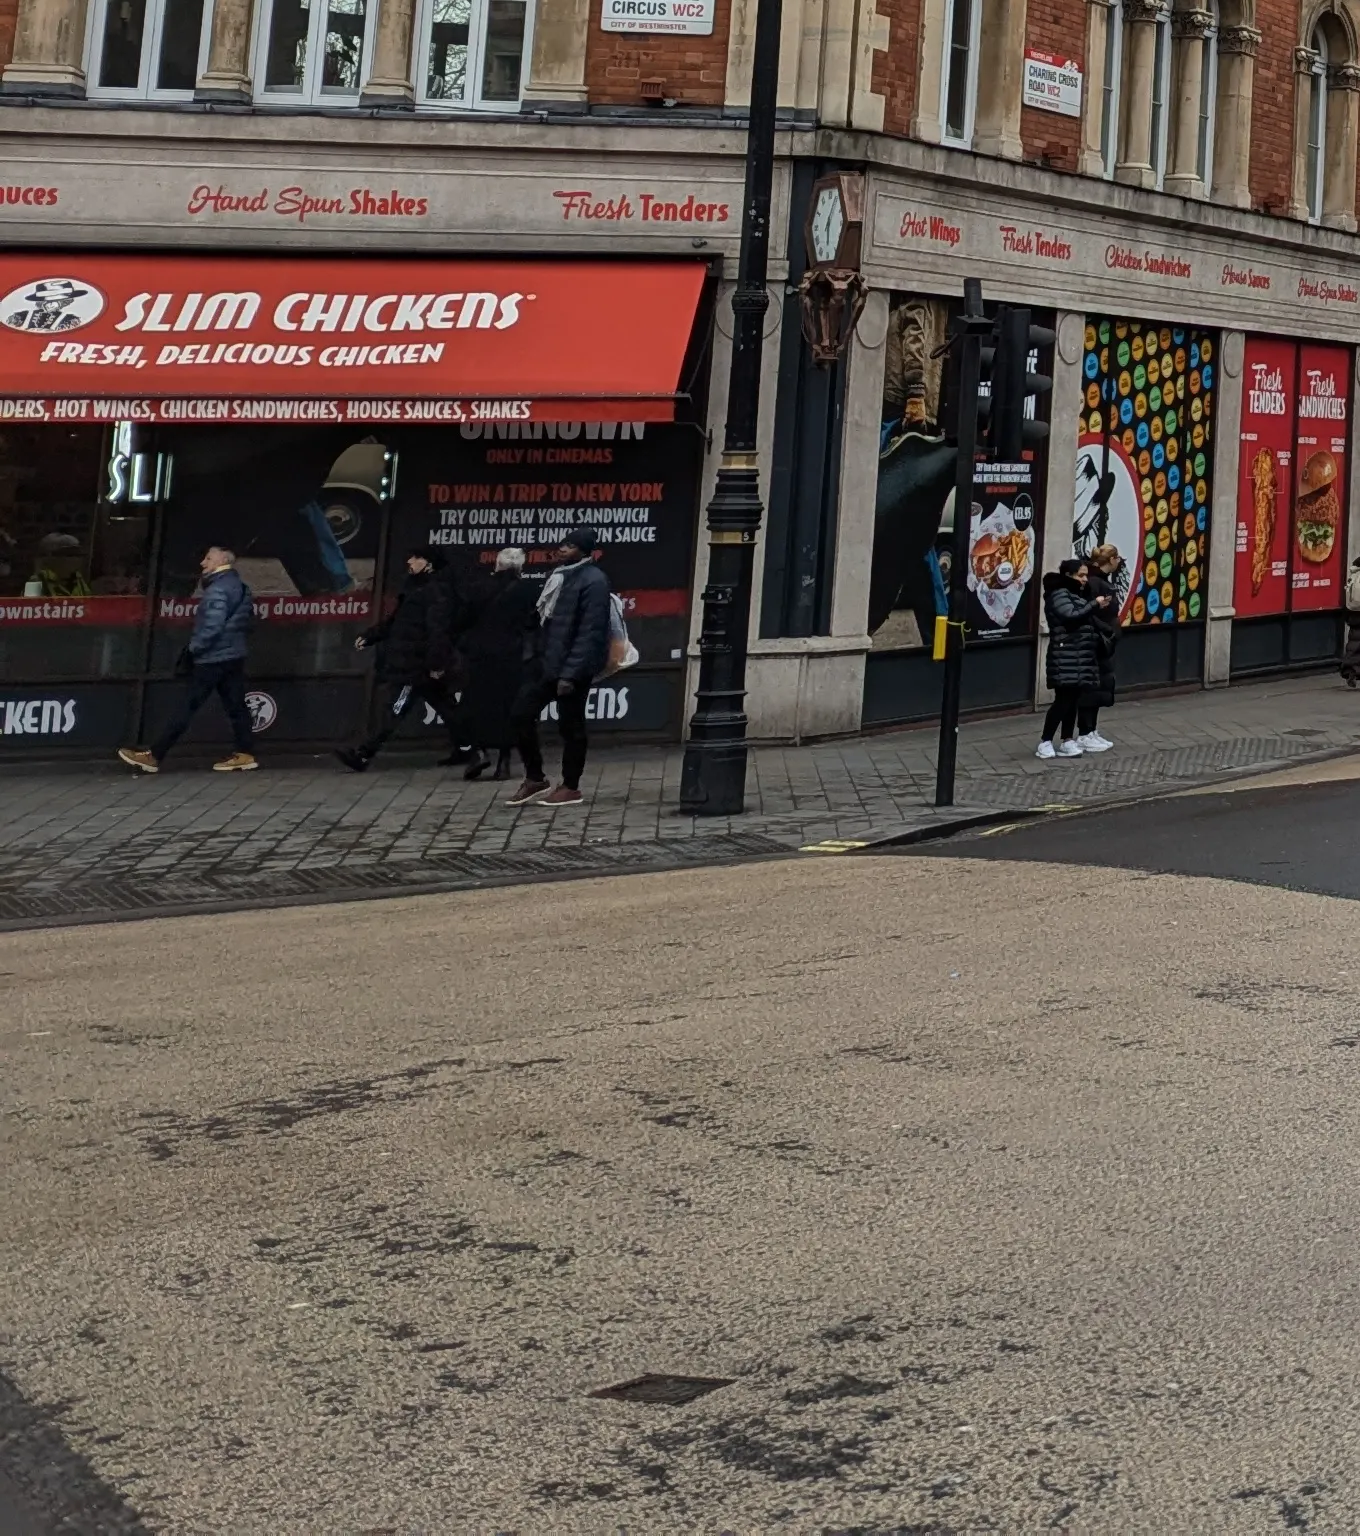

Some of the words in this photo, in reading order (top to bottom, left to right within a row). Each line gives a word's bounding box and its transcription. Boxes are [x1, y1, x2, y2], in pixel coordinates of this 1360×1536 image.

[611, 1, 667, 15] CIRCUS
[672, 3, 705, 18] WC2
[1028, 79, 1046, 94] ROAD
[1029, 65, 1057, 83] CHARING
[1058, 72, 1079, 88] CROSS
[187, 185, 268, 214] Hand
[274, 187, 345, 222] Spun
[349, 189, 428, 215] Shakes
[553, 191, 635, 220] Fresh
[639, 194, 729, 222] Tenders
[900, 211, 928, 238] Hot
[929, 216, 961, 247] Wings
[999, 225, 1033, 255] Fresh
[1034, 231, 1072, 261] Tenders
[1104, 244, 1143, 272] Chicken
[1143, 251, 1191, 279] Sandwiches
[1221, 264, 1248, 286] House
[1248, 268, 1271, 290] Sauces
[114, 291, 262, 332] SLIM
[273, 291, 524, 332] CHICKENS
[40, 341, 148, 369] FRESH,
[155, 343, 314, 366] DELICIOUS
[318, 342, 445, 367] CHICKEN
[1251, 363, 1282, 391] Fresh
[1306, 369, 1336, 396] Fresh
[0, 400, 50, 421] DERS,
[54, 400, 91, 418] HOT
[93, 400, 156, 422] WINGS,
[160, 400, 231, 418] CHICKEN
[232, 400, 343, 422] SANDWICHES,
[346, 400, 402, 419] HOUSE
[404, 401, 467, 422] SAUCES,
[470, 401, 532, 419] SHAKES
[1249, 390, 1286, 415] TENDERS
[486, 448, 524, 464] ONLY
[527, 448, 543, 463] IN
[546, 448, 613, 464] CINEMAS
[428, 484, 449, 503] TO
[452, 484, 490, 503] WIN
[493, 484, 504, 503] A
[508, 484, 547, 503] TRIP
[551, 484, 572, 502] TO
[575, 483, 615, 502] NEW
[618, 483, 664, 502] YORK
[439, 509, 466, 526] TRY
[468, 509, 499, 525] OUR
[501, 508, 534, 525] NEW
[537, 508, 575, 525] YORK
[575, 507, 649, 525] SANDWICH
[428, 528, 465, 546] MEAL
[467, 528, 506, 545] WITH
[508, 527, 536, 545] THE
[615, 526, 656, 543] SAUCE
[743, 531, 750, 542] 5
[273, 597, 369, 616] downstairs
